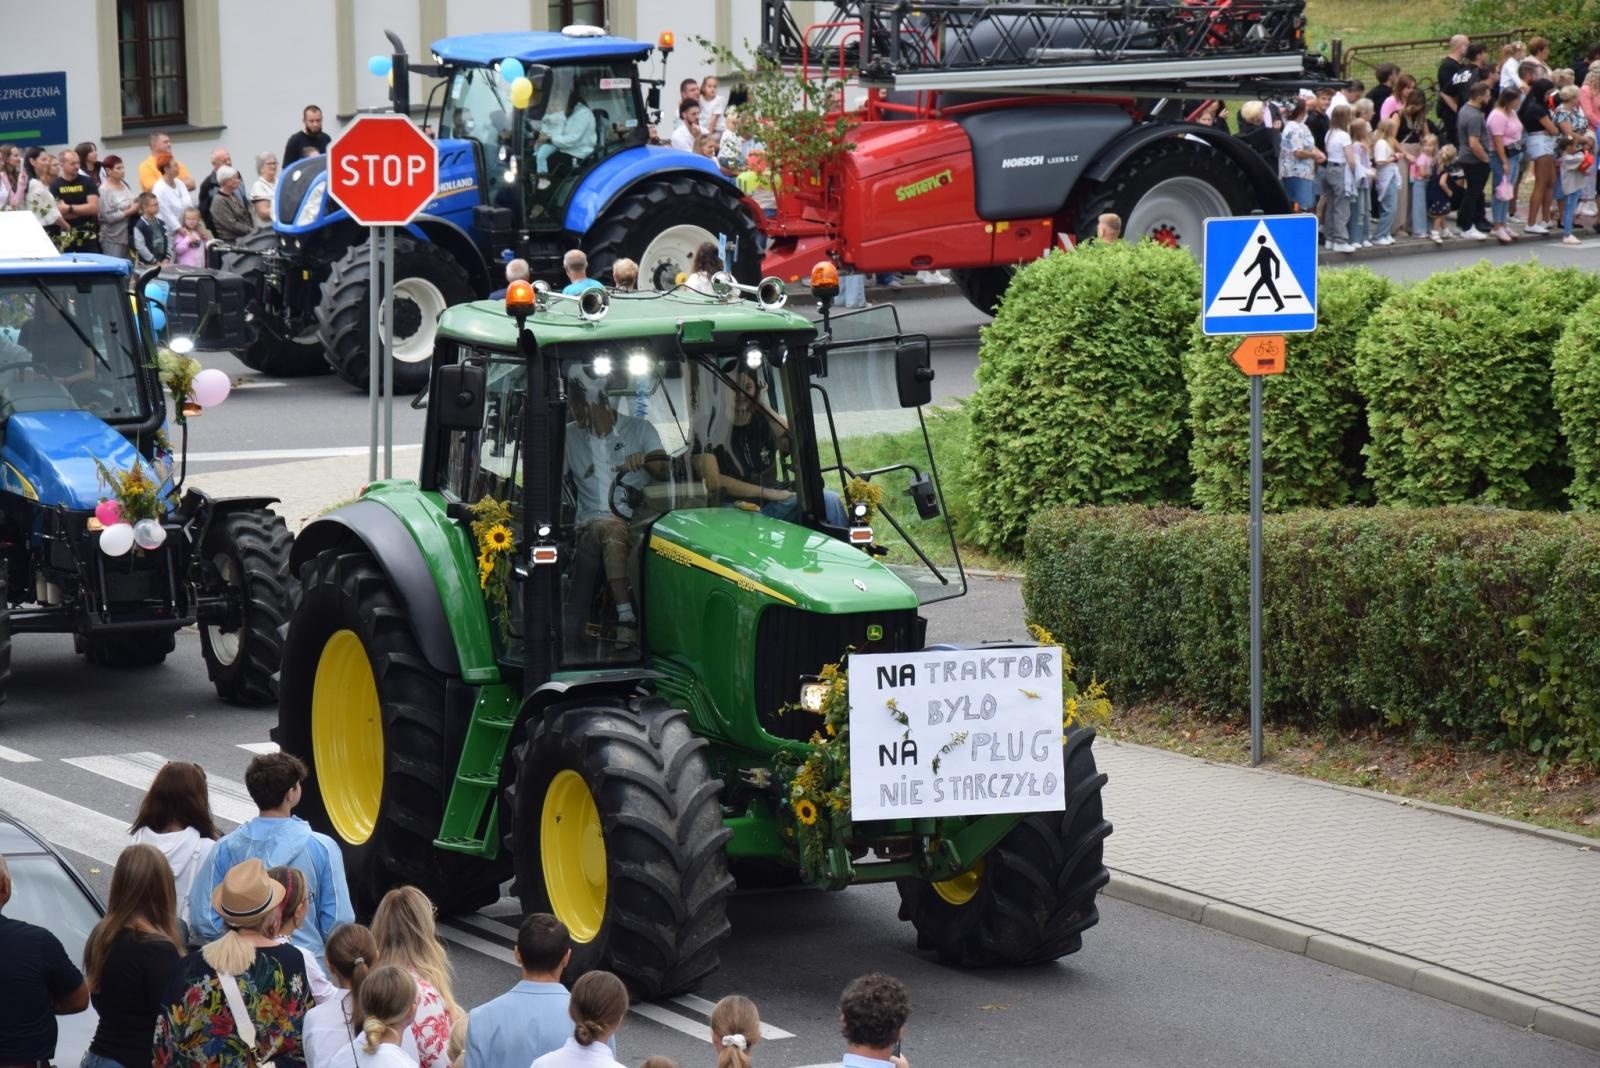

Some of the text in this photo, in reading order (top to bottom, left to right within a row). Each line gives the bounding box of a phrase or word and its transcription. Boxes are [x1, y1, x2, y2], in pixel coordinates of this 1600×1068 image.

[340, 154, 426, 187] STOP
[1002, 155, 1044, 168] HORSCH
[438, 177, 473, 192] HOLLAND
[876, 652, 1053, 690] NA TRAKTOR
[927, 693, 997, 726] BYŁO
[878, 729, 1052, 766] NA PŁUG
[933, 771, 1058, 803] STARCZYŁO
